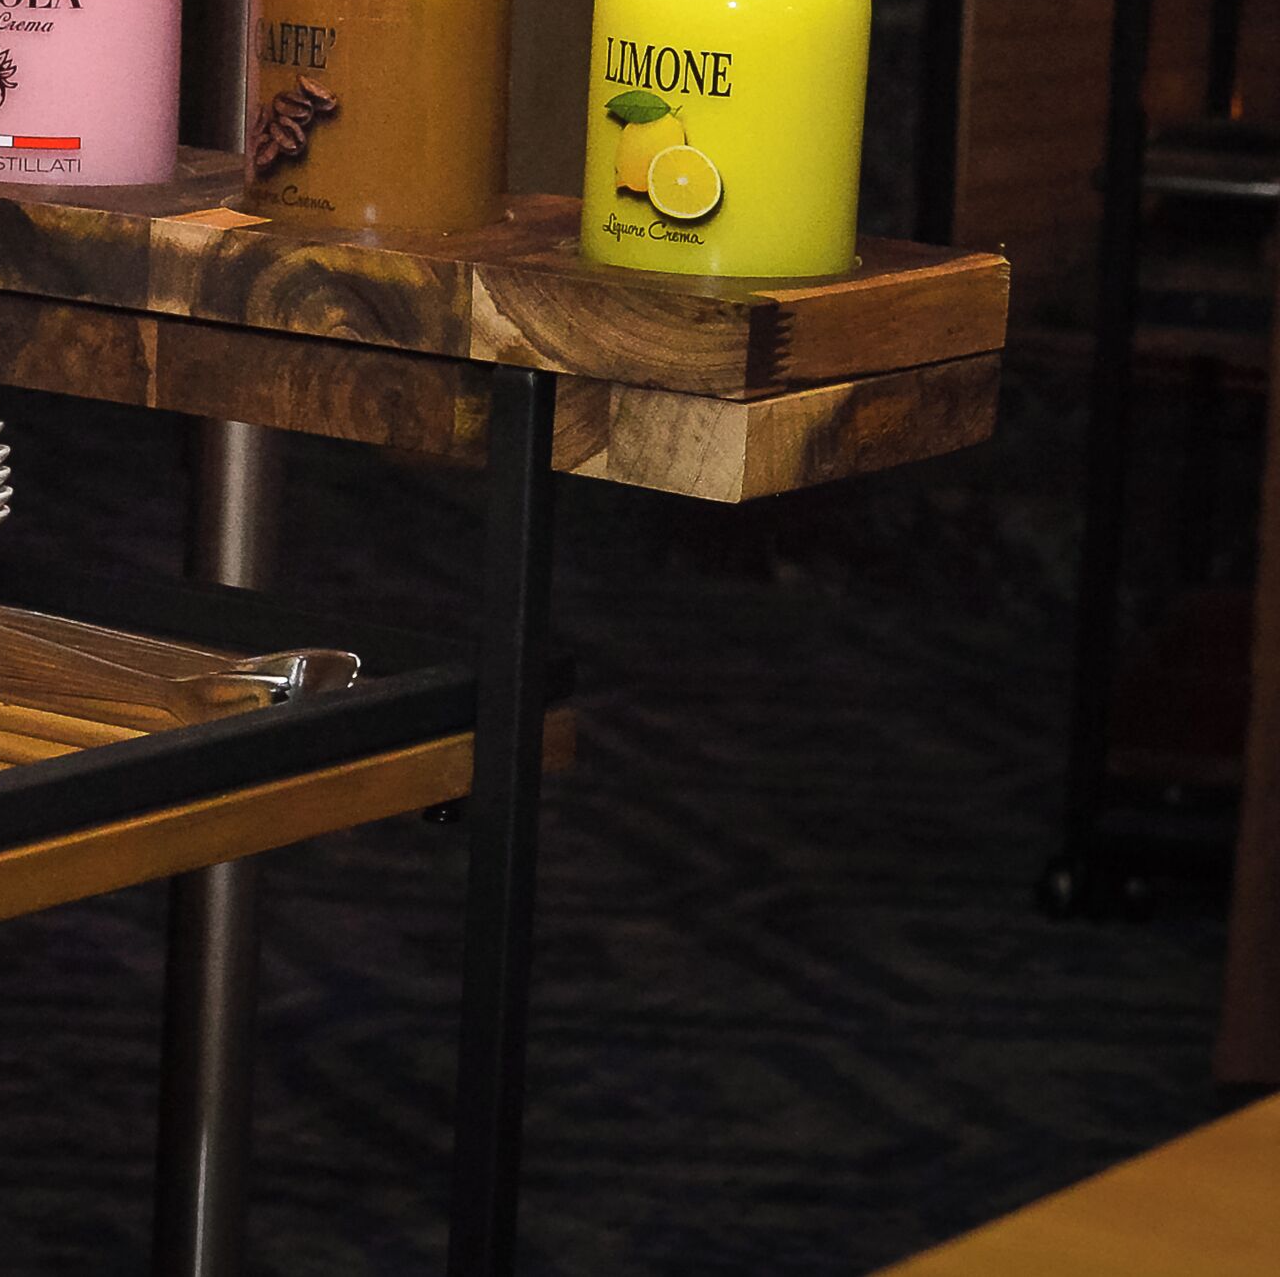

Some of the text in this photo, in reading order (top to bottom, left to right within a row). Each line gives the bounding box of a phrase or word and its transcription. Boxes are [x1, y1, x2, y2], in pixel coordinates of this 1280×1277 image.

[604, 36, 733, 98] LIMONE
[281, 184, 337, 212] Crema
[602, 212, 705, 245] Liquore Crema
